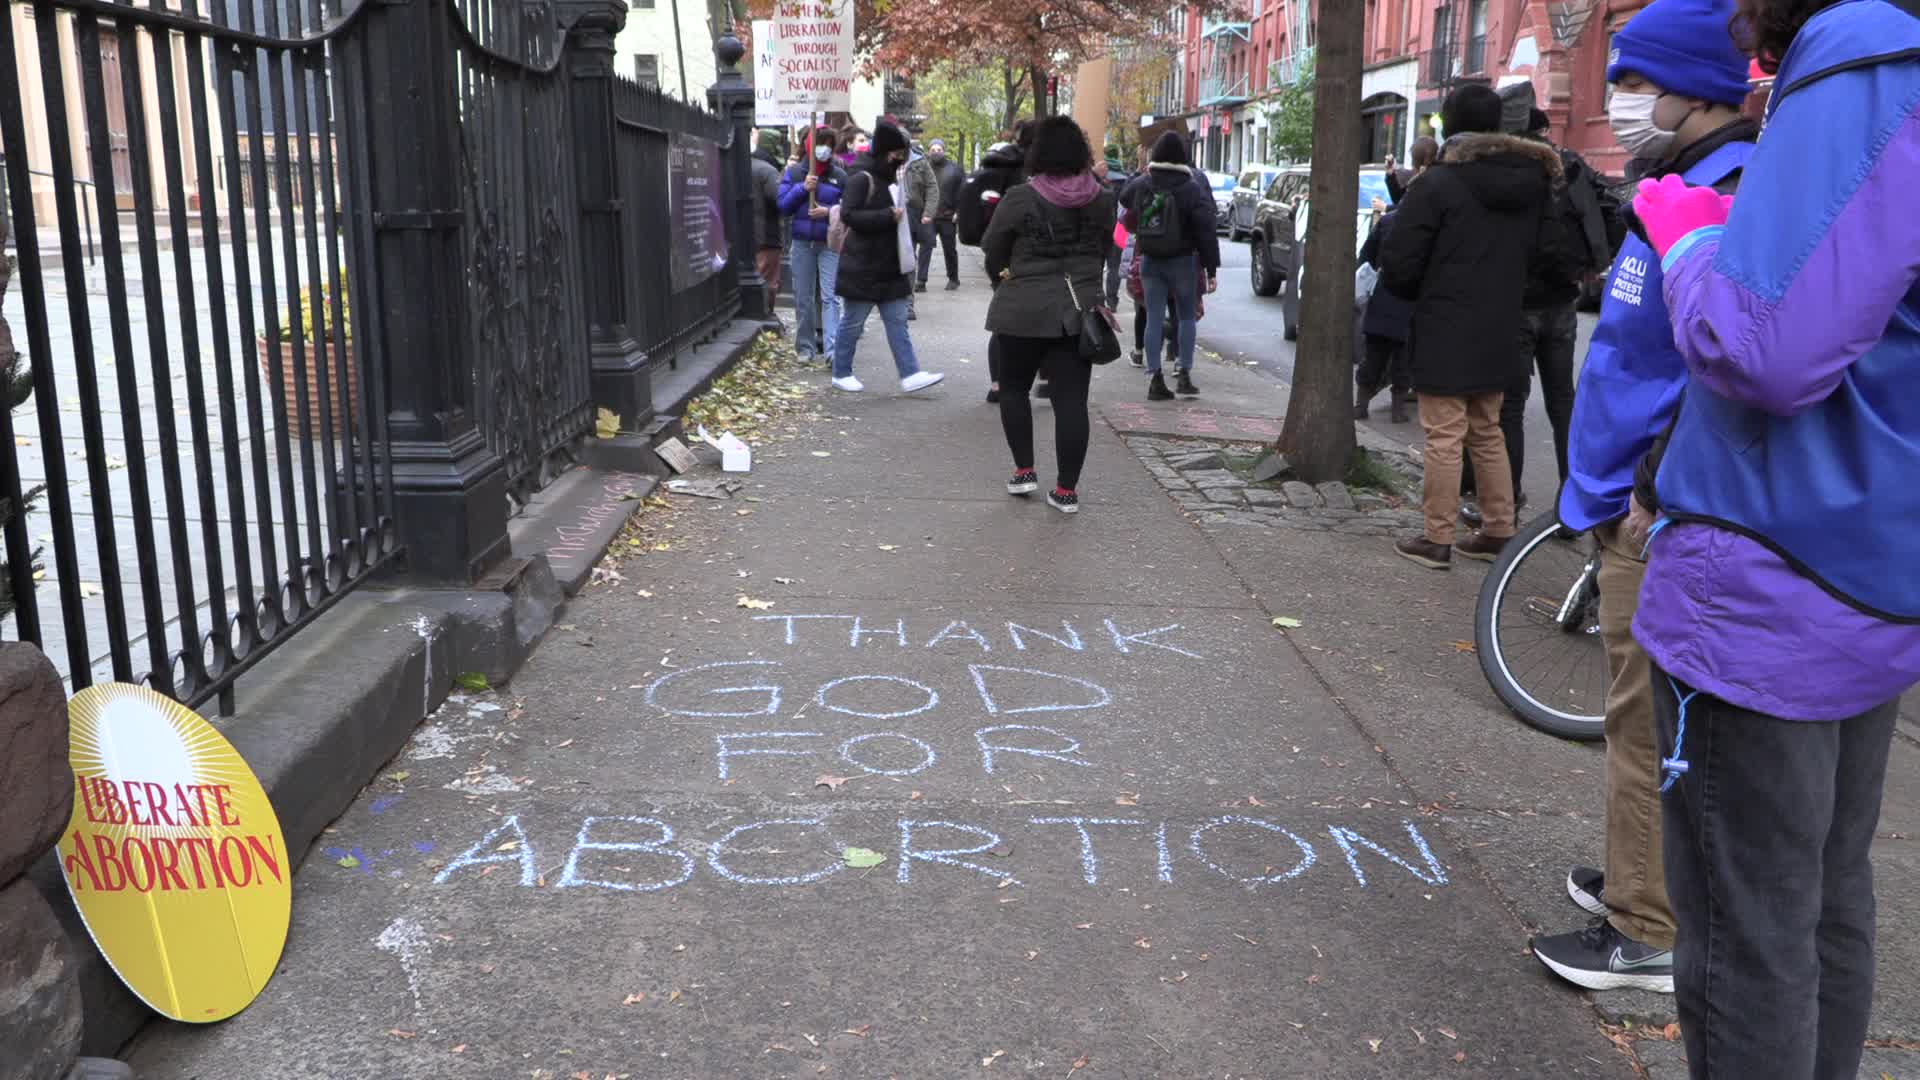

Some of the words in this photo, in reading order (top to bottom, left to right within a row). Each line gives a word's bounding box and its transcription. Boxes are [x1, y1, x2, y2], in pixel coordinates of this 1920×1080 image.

[780, 22, 842, 39] LIBERATION
[793, 42, 838, 57] THROUGH
[778, 58, 840, 75] SOCIALIST
[788, 78, 849, 93] REVOLUTION
[1620, 255, 1647, 277] ACLU
[750, 613, 1204, 660] THANK
[644, 659, 1112, 720] GOD
[715, 724, 1093, 780] FOR
[78, 775, 240, 827] LIBERATE
[65, 830, 283, 894] ABORTION
[432, 814, 1450, 891] ABORTION
